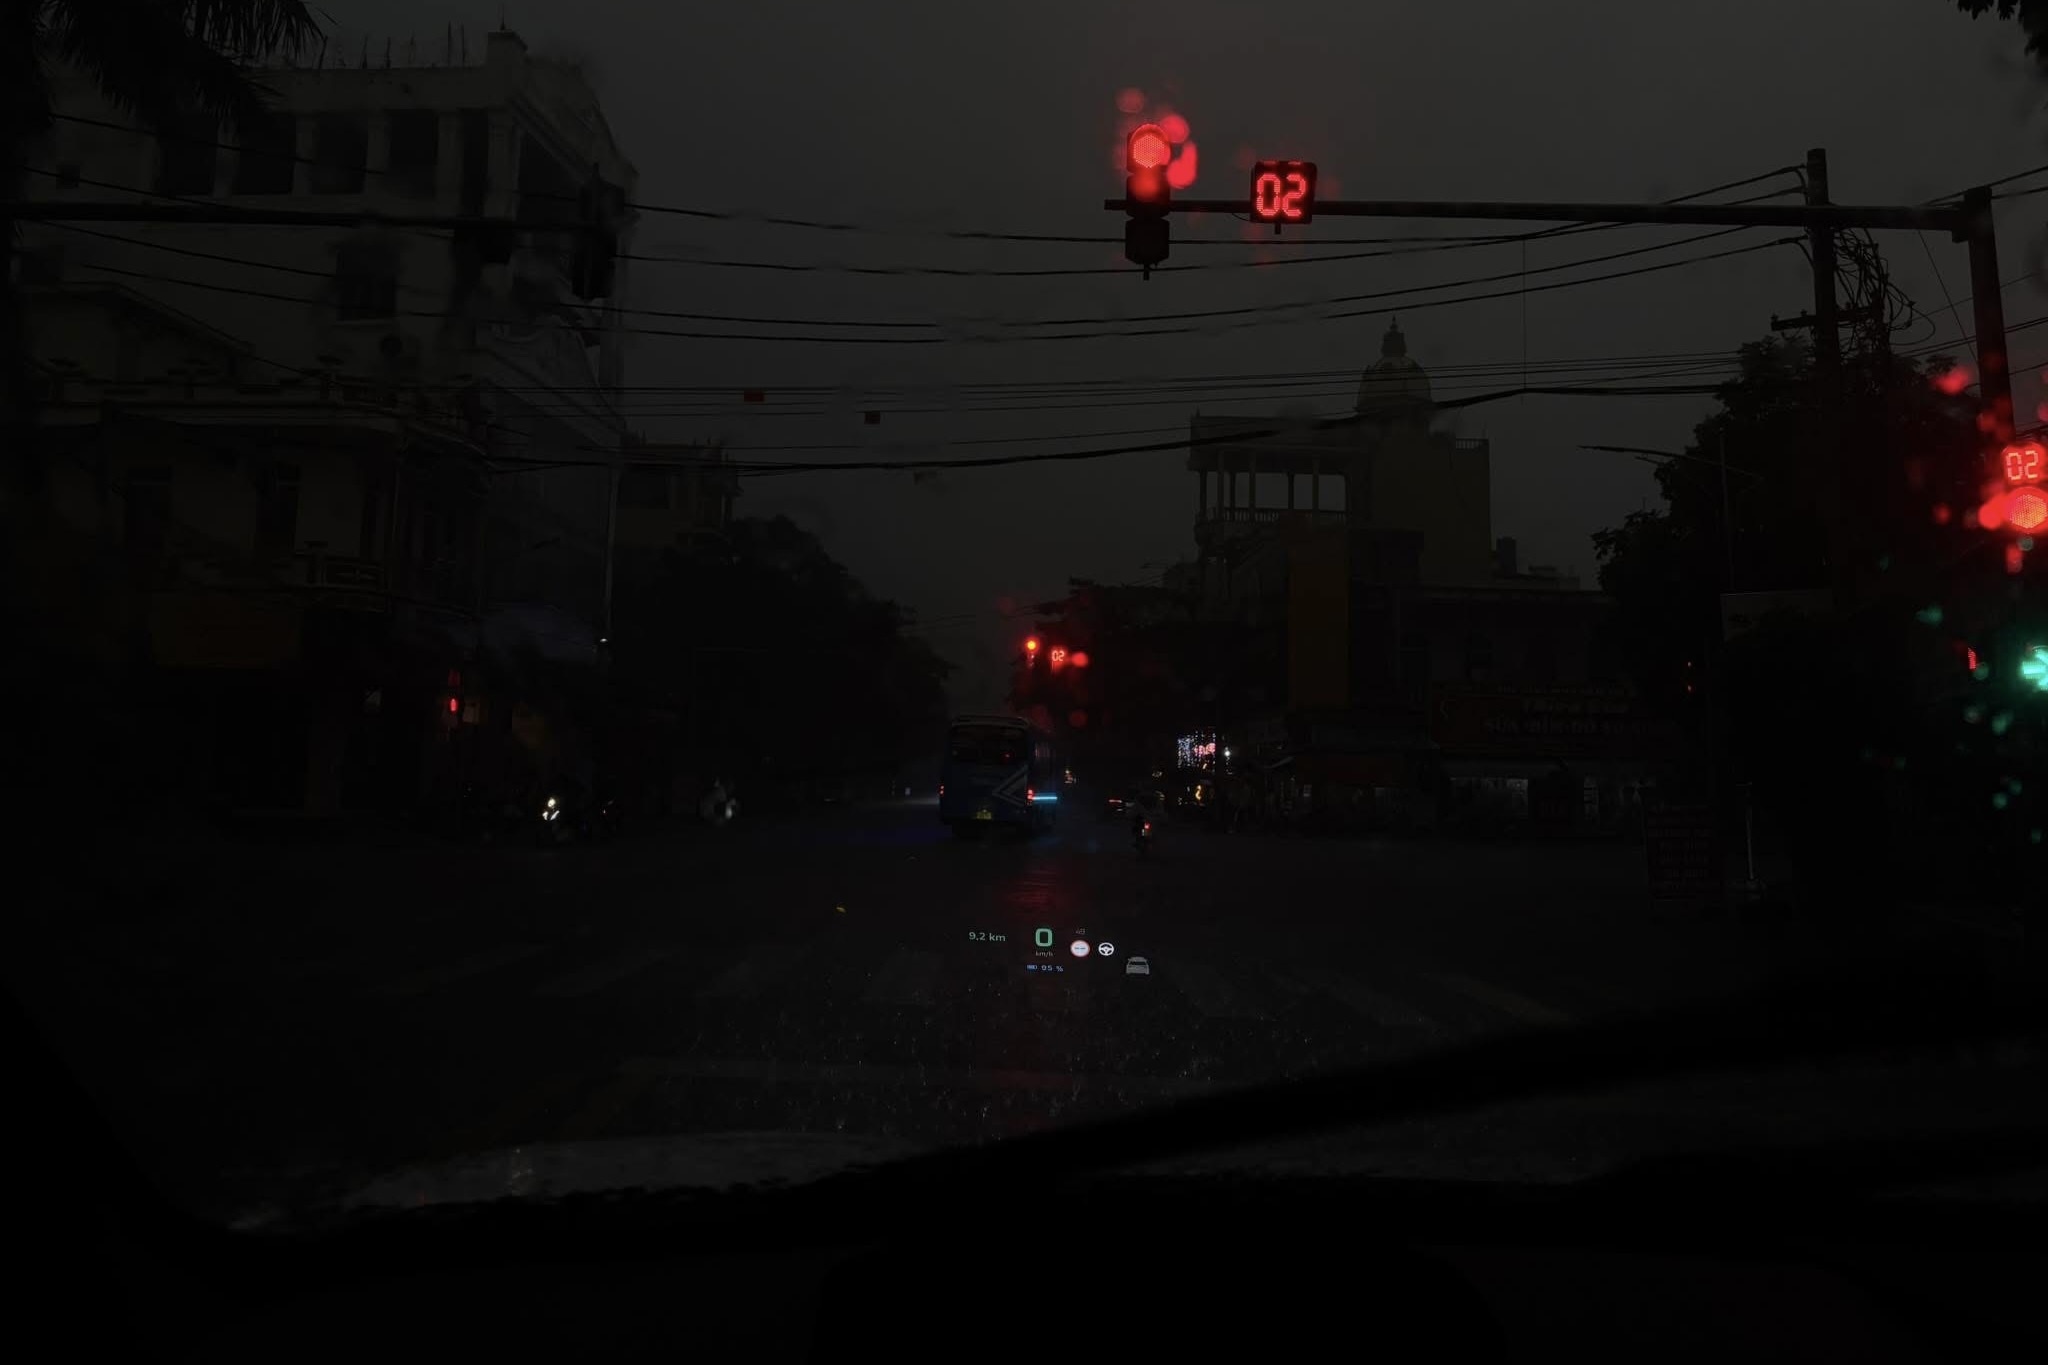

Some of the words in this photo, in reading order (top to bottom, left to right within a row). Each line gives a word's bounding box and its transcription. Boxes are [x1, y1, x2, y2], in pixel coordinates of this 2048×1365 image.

[1257, 174, 1306, 216] 02
[2006, 450, 2039, 480] 02
[1052, 650, 1065, 661] 02
[989, 933, 1006, 942] km
[1036, 928, 1053, 947] 0
